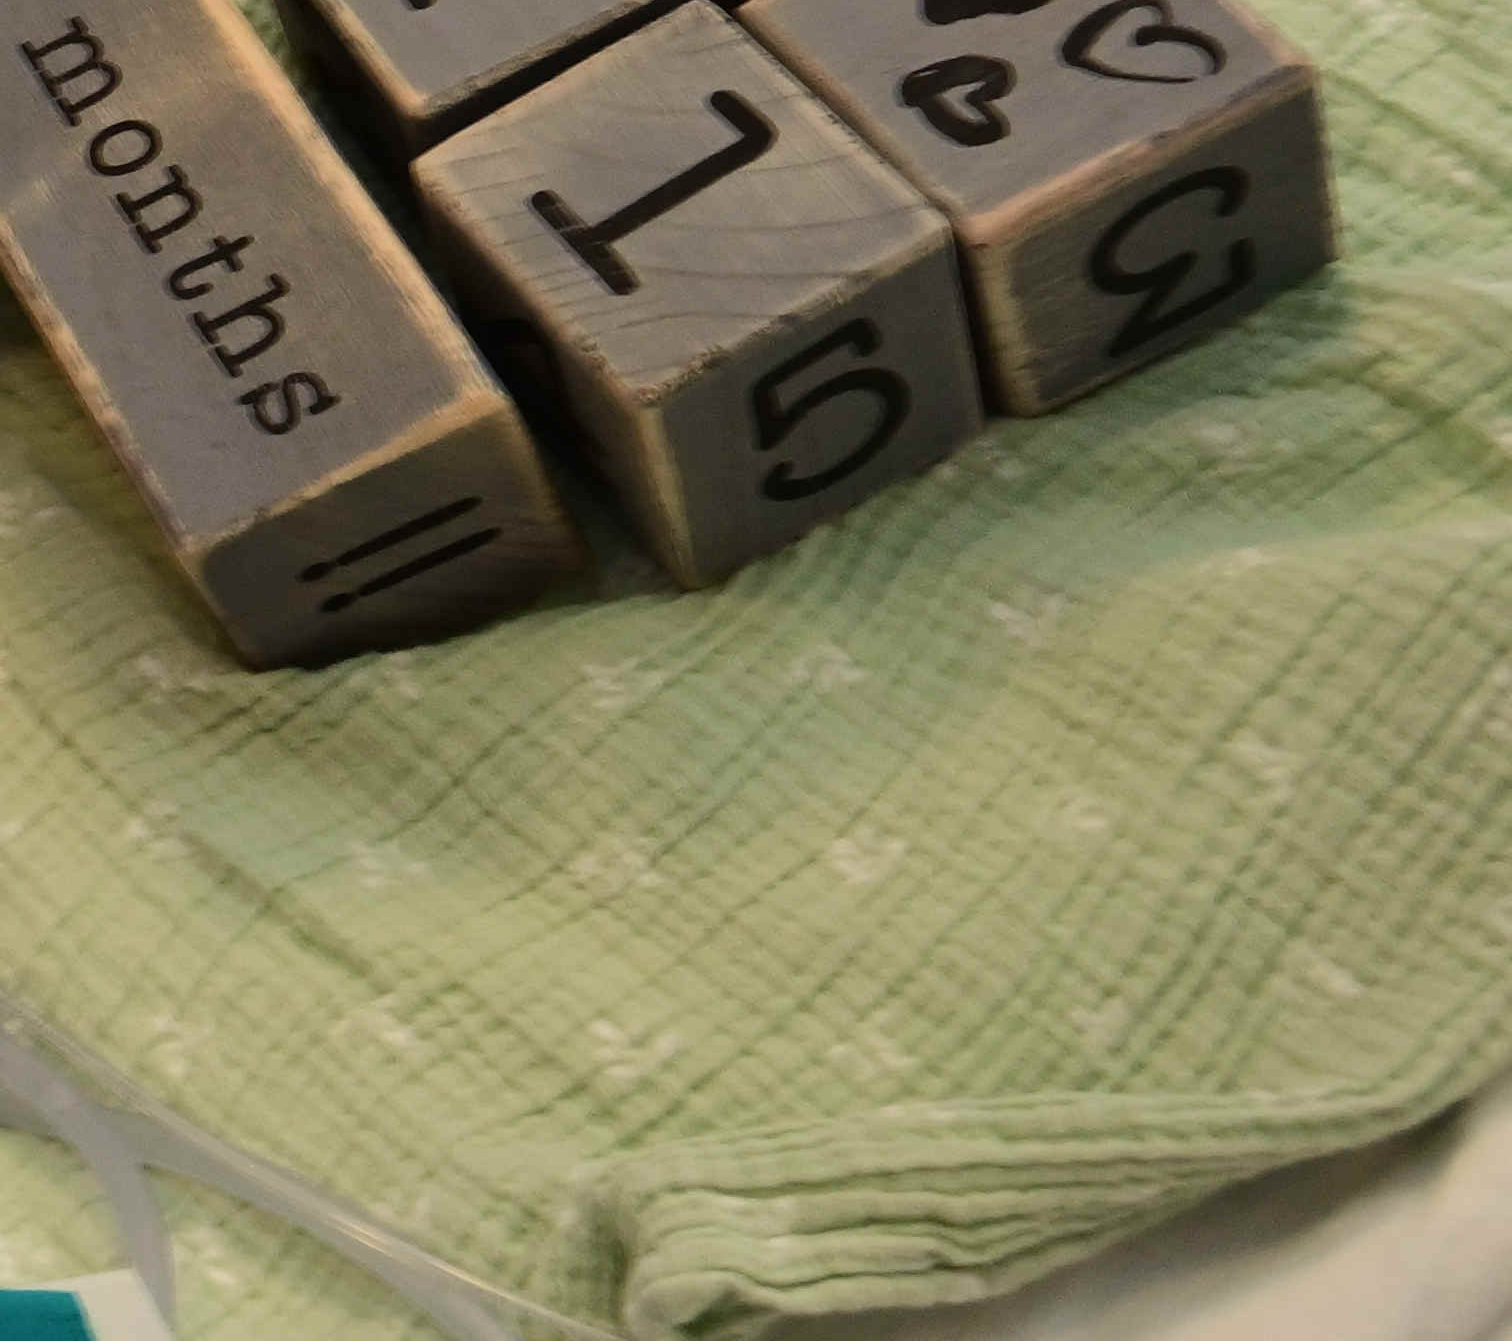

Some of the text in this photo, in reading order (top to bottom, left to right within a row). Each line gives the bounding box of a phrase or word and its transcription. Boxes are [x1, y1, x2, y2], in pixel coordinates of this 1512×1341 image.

[20, 16, 343, 436] months
[527, 90, 780, 296] 1
[751, 318, 912, 502] 5
